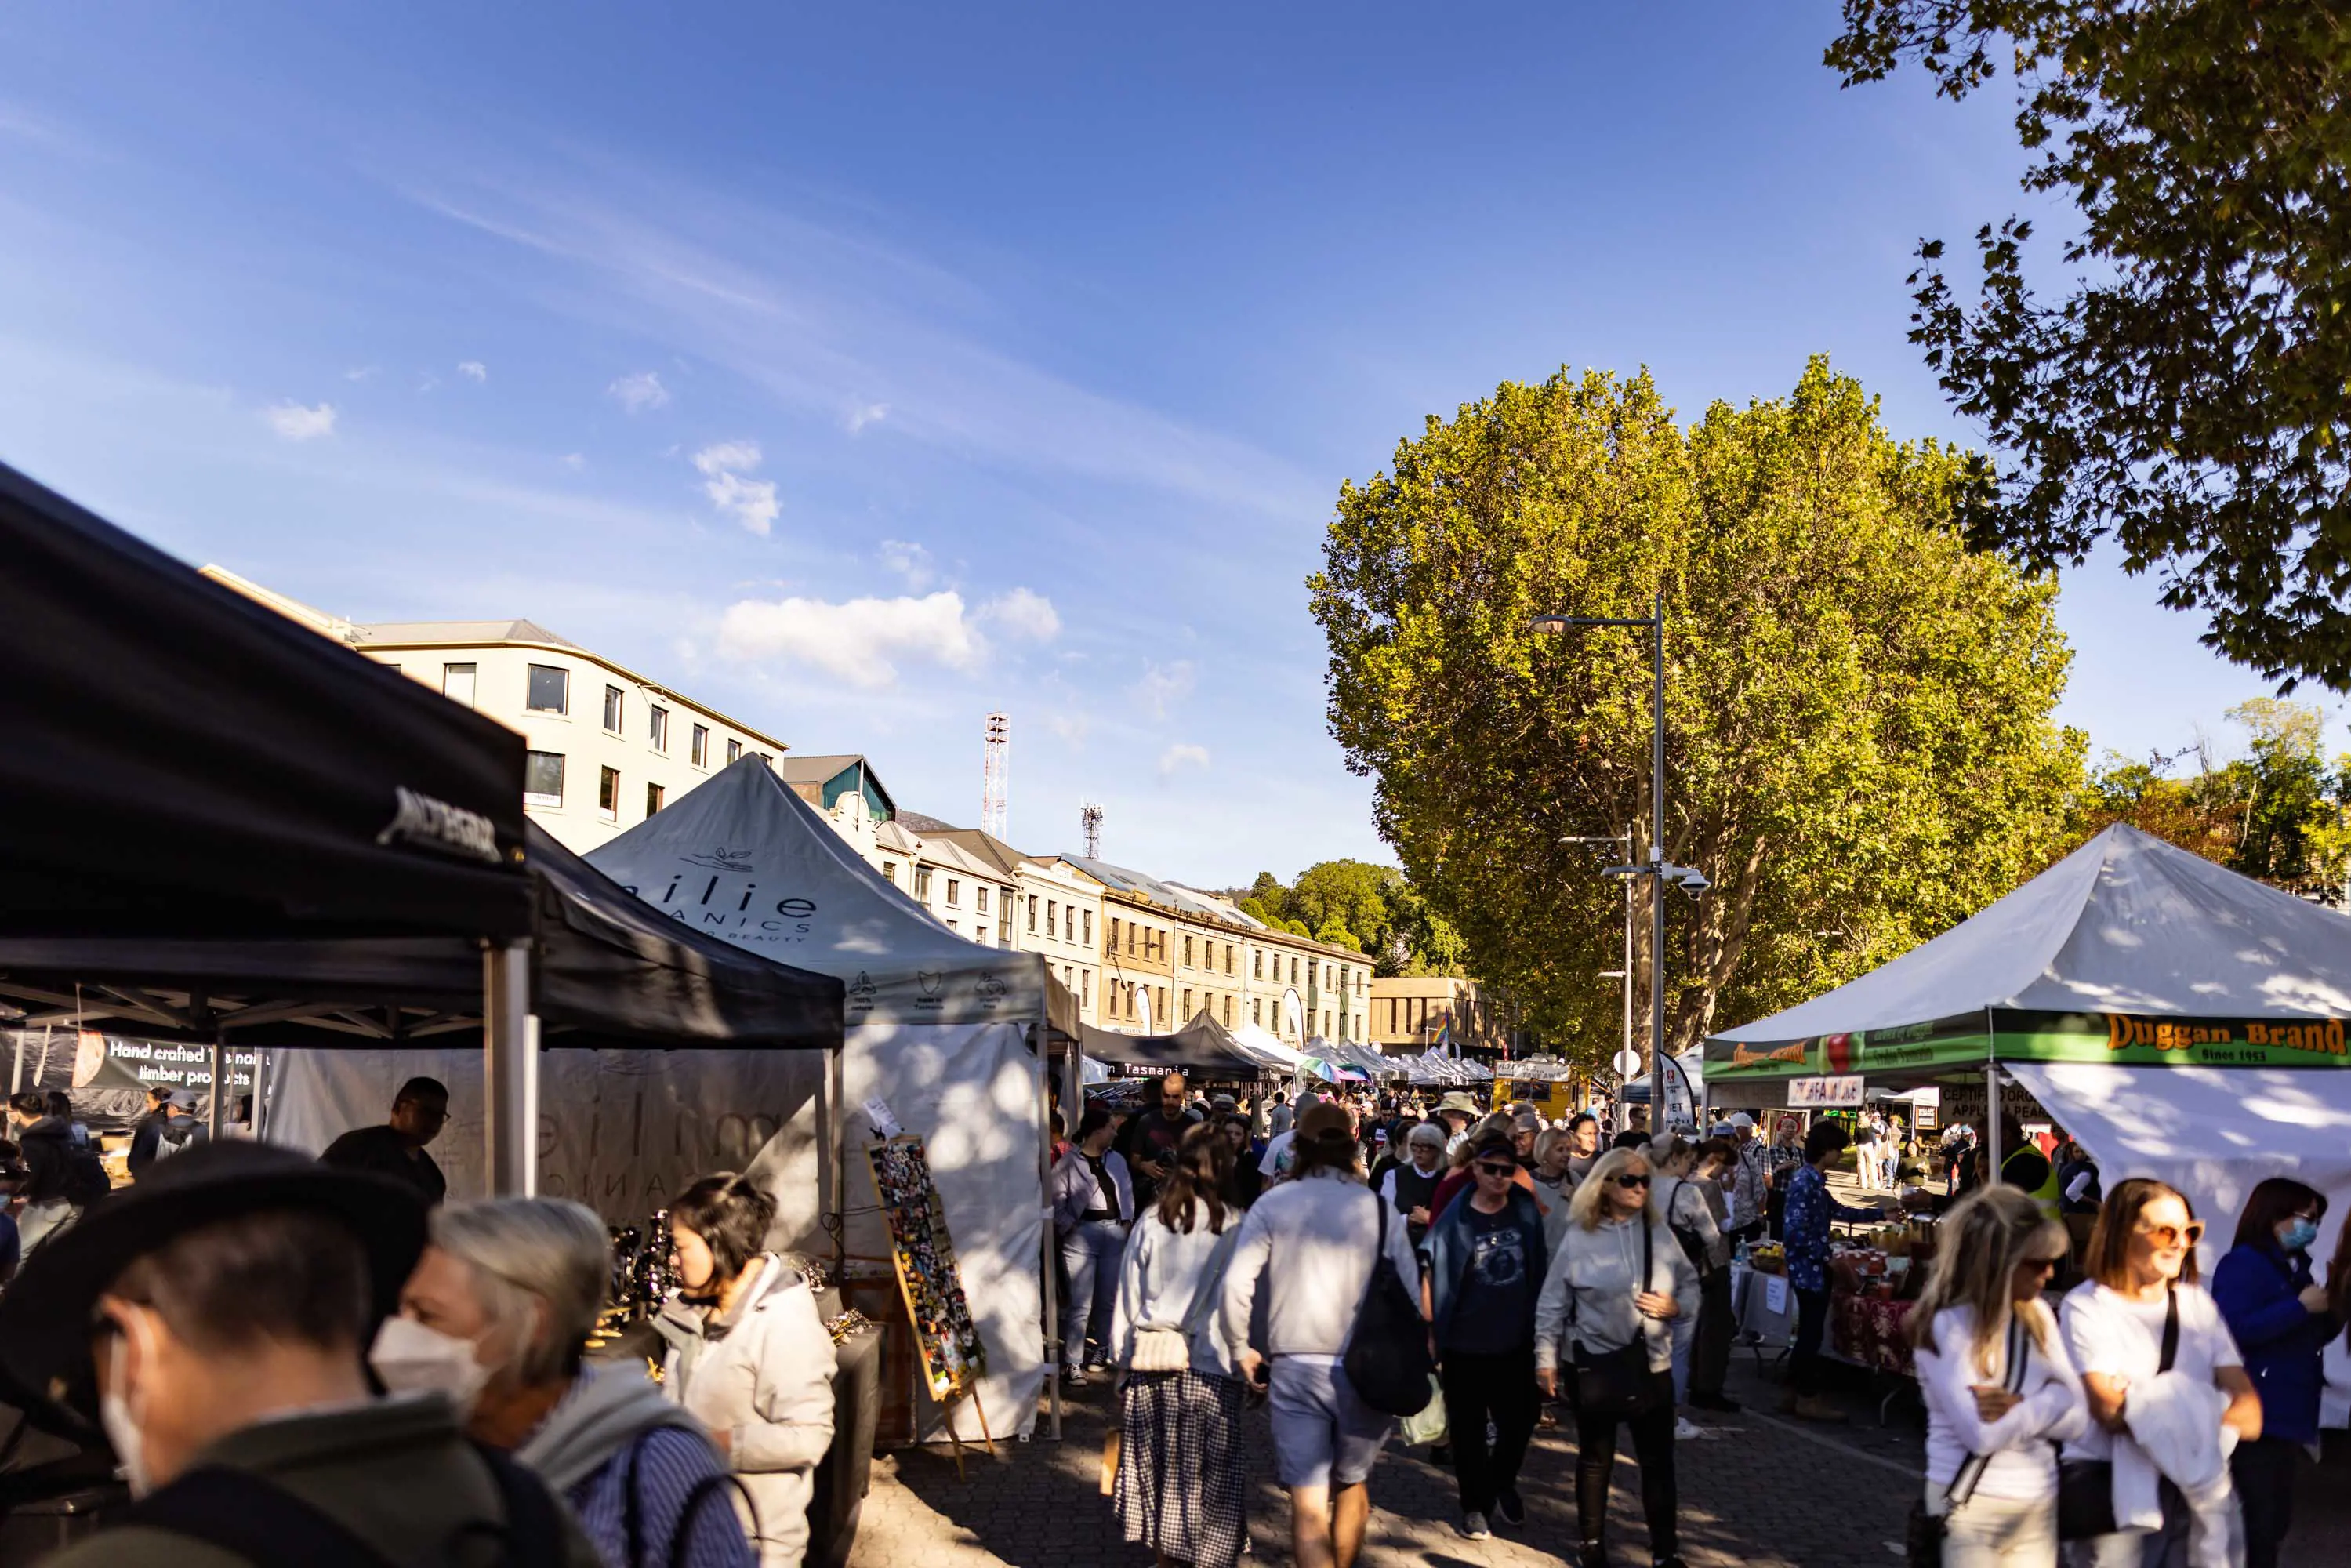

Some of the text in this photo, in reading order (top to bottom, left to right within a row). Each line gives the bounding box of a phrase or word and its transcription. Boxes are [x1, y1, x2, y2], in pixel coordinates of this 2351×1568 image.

[2107, 1014, 2348, 1055] Duggan Brand
[110, 1040, 151, 1058] Hand
[154, 1044, 204, 1062] crafted
[2202, 1048, 2233, 1060] Since
[139, 1063, 184, 1081] timber
[1124, 1063, 1189, 1076] Tasmania
